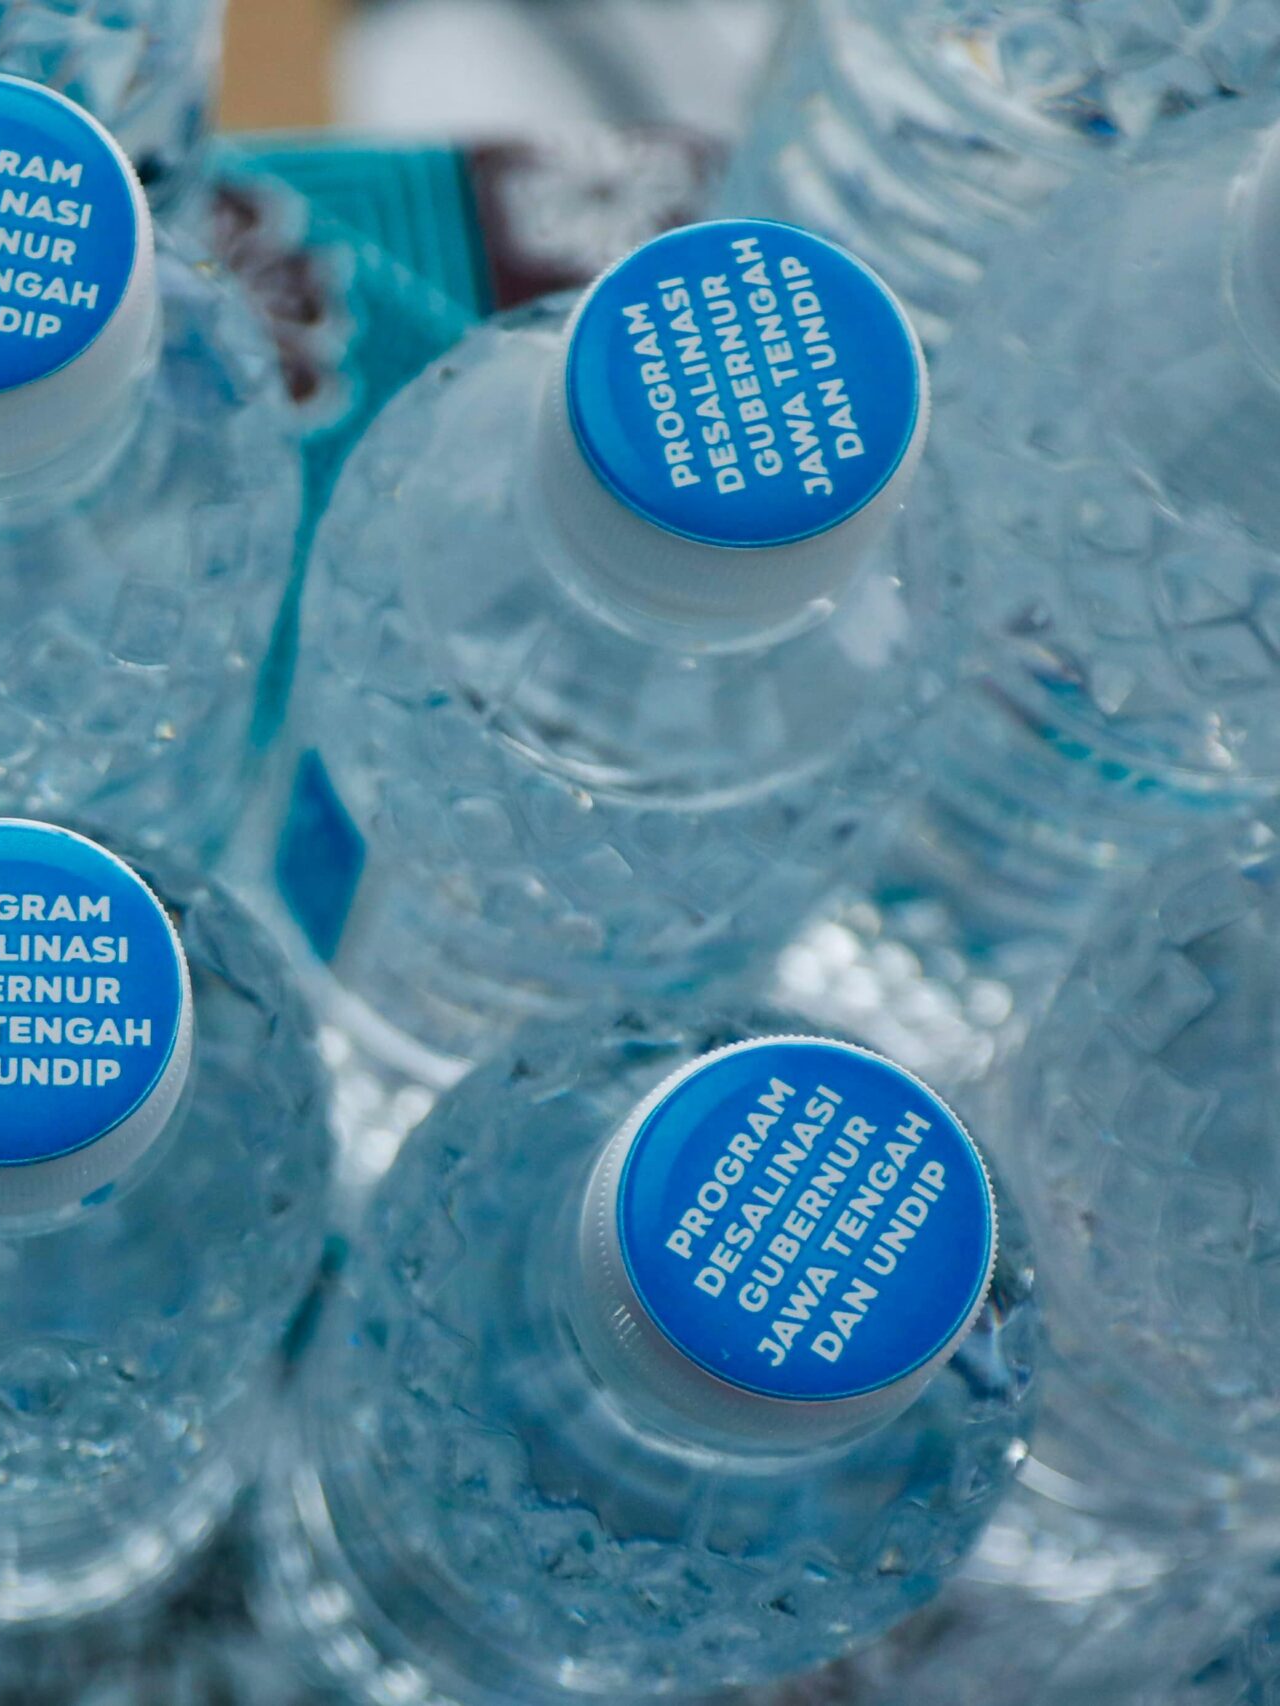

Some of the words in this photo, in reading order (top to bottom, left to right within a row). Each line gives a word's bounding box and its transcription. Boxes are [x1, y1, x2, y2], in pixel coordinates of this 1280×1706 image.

[622, 303, 701, 488] PROGRAM
[658, 277, 746, 494] DESALINASI
[701, 274, 783, 477] GUBERNUR
[731, 237, 798, 387] TENGAH
[780, 256, 836, 370] UNDIP
[782, 391, 833, 495] JAWA
[817, 378, 864, 459] DAN
[666, 1077, 796, 1259] PROGRAM
[694, 1085, 842, 1297] DESALINASI
[738, 1116, 877, 1312] GUBERNUR
[757, 1267, 838, 1367] JAWA
[821, 1111, 931, 1256] TENGAH
[811, 1278, 878, 1362] DAN
[863, 1161, 945, 1275] UNDIP
